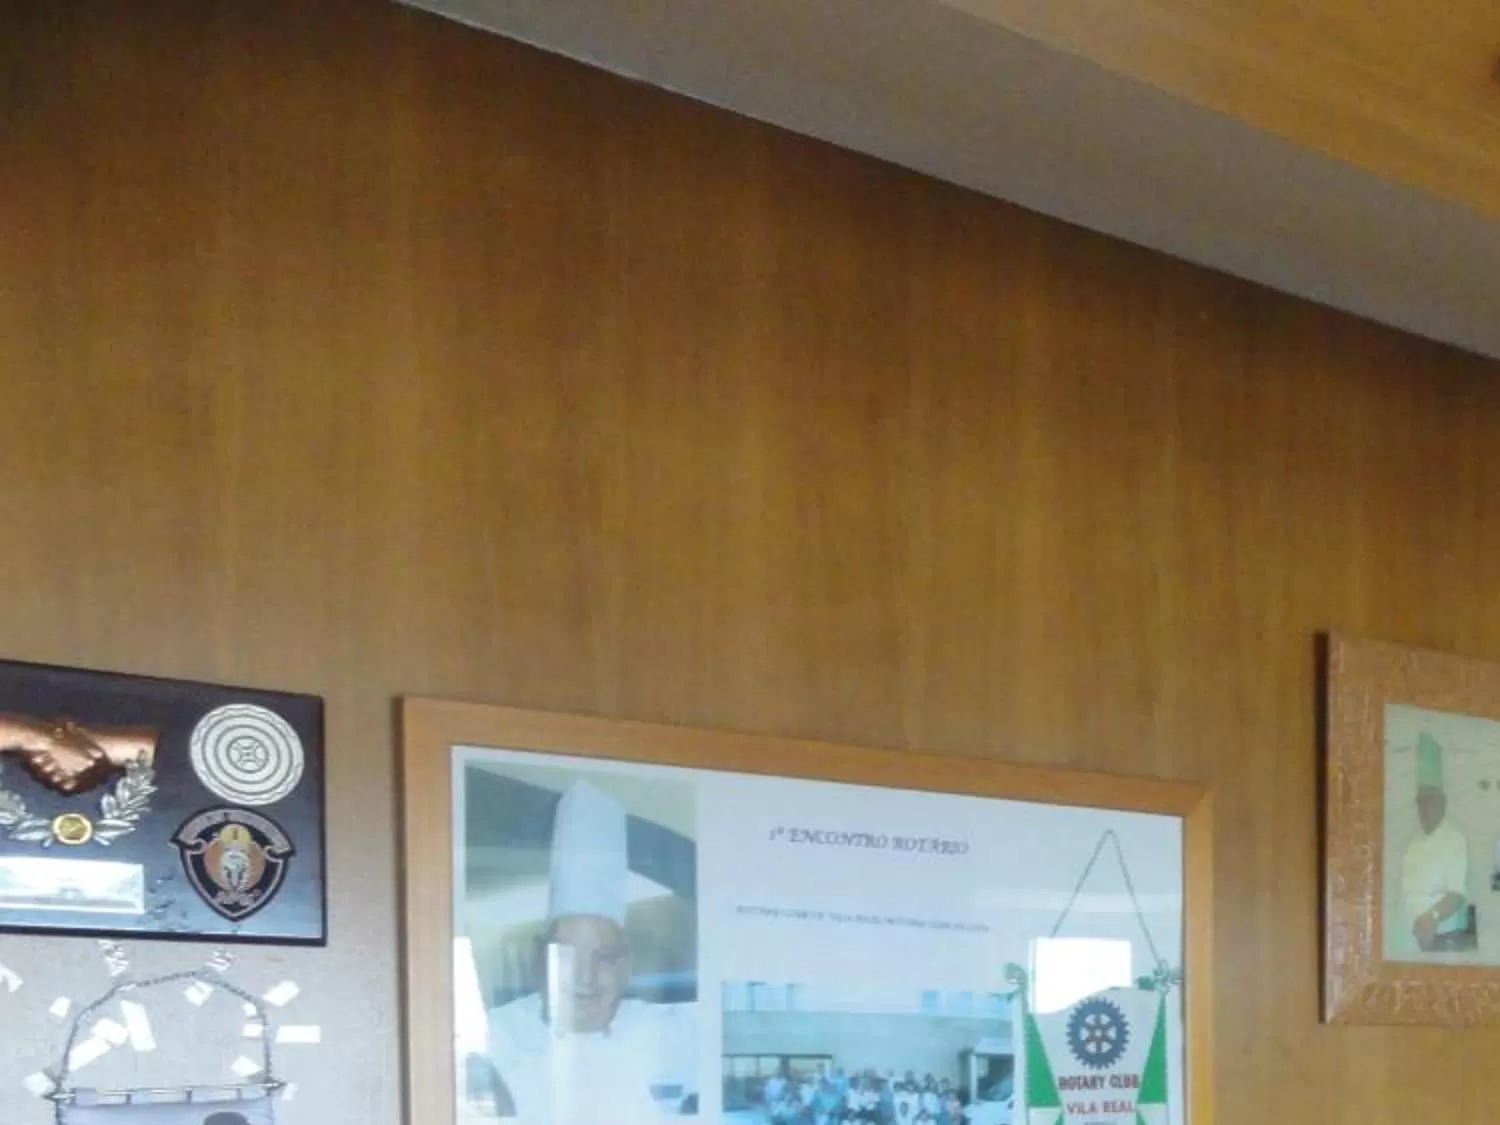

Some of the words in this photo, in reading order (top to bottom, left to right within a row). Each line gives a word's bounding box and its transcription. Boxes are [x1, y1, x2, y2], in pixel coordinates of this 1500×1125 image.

[788, 827, 889, 849] ENCONTRO
[1057, 1074, 1105, 1091] ROTARY
[1109, 1073, 1139, 1089] CLUB
[1066, 1101, 1098, 1116] VILA
[1102, 1099, 1136, 1114] REAL
